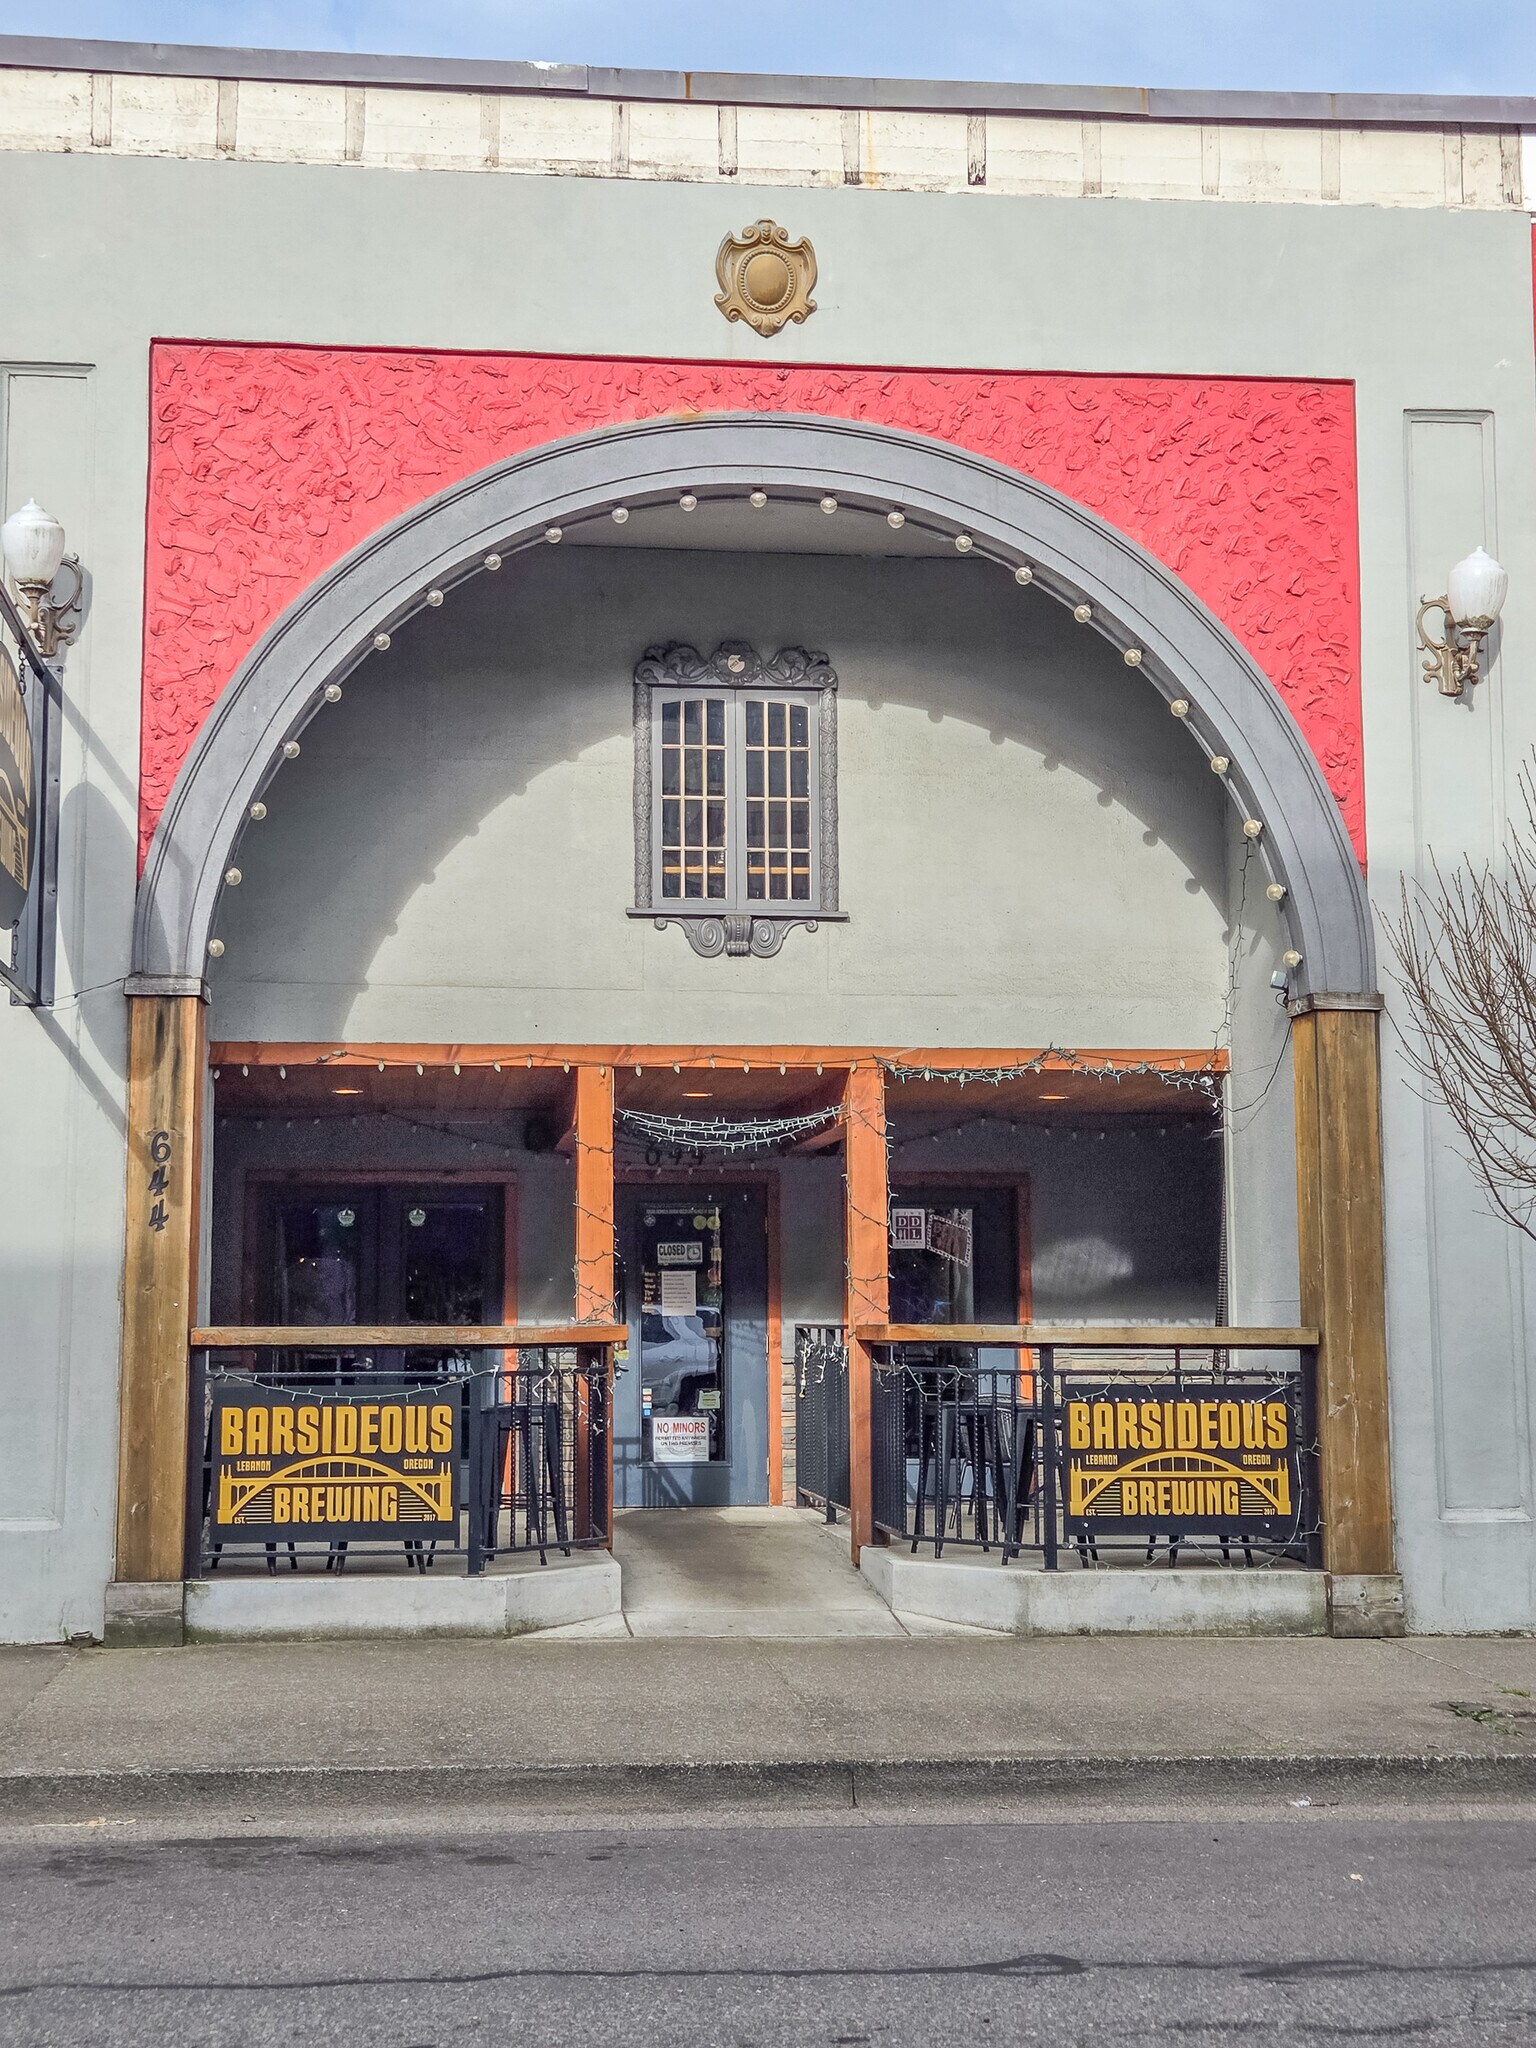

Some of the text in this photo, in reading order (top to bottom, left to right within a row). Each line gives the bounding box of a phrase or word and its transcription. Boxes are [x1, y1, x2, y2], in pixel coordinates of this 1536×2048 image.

[148, 1131, 171, 1232] 644
[658, 1244, 686, 1256] CLOSED
[221, 1405, 453, 1456] BARSIDEOUS
[656, 1422, 706, 1434] NO MINORS
[1069, 1402, 1288, 1450] BARSIDEOUS
[403, 1458, 434, 1470] OREGON
[1085, 1454, 1118, 1466] LEBANON
[1242, 1454, 1271, 1465] OREGON
[237, 1460, 271, 1472] LEBANON
[1122, 1480, 1239, 1516] BREWING
[273, 1485, 398, 1524] BREWING
